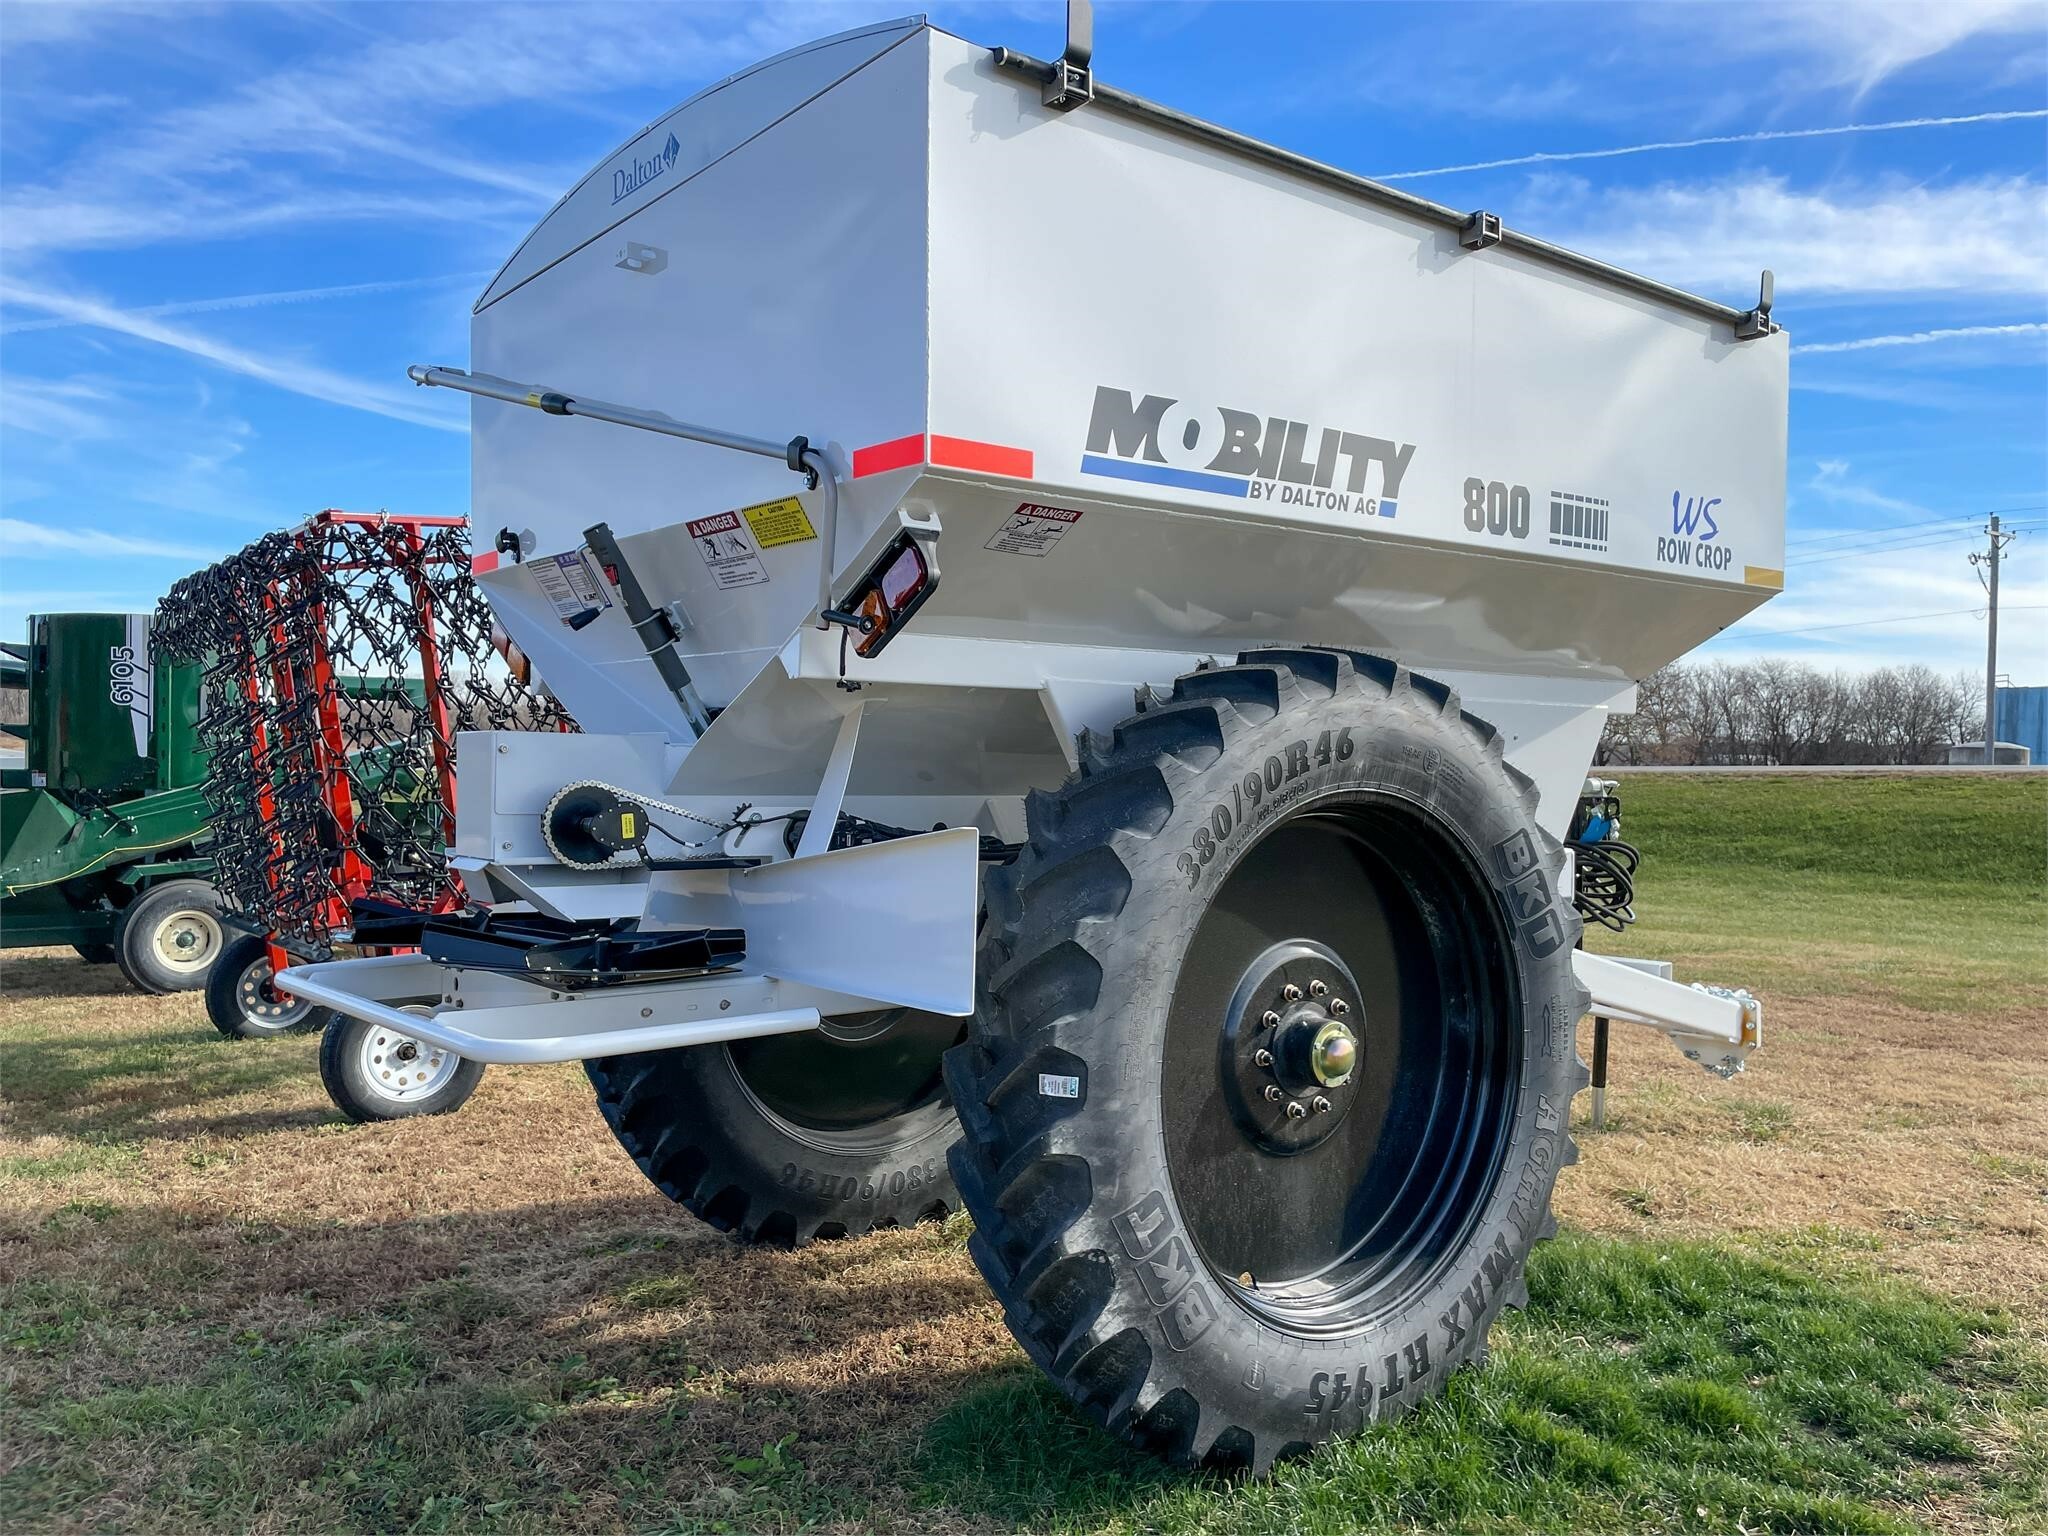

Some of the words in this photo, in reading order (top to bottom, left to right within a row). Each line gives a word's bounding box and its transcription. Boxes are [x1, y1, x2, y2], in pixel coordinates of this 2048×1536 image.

[613, 157, 662, 200] Dalton
[1085, 386, 1417, 499] MOBILITY
[700, 514, 737, 533] DANGER
[1033, 507, 1077, 521] DANGER
[1250, 481, 1277, 501] BY
[1281, 485, 1350, 512] DALTON
[1354, 497, 1377, 516] AG
[1464, 477, 1530, 539] 800
[1673, 490, 1722, 541] WS
[1657, 536, 1692, 565] ROW
[1696, 543, 1732, 571] CROP
[110, 646, 135, 706] 6105
[1176, 727, 1355, 892] 380/90R46
[1500, 831, 1562, 950] BKT
[777, 1157, 937, 1202] 380/90R46
[1124, 1203, 1212, 1345] BKT
